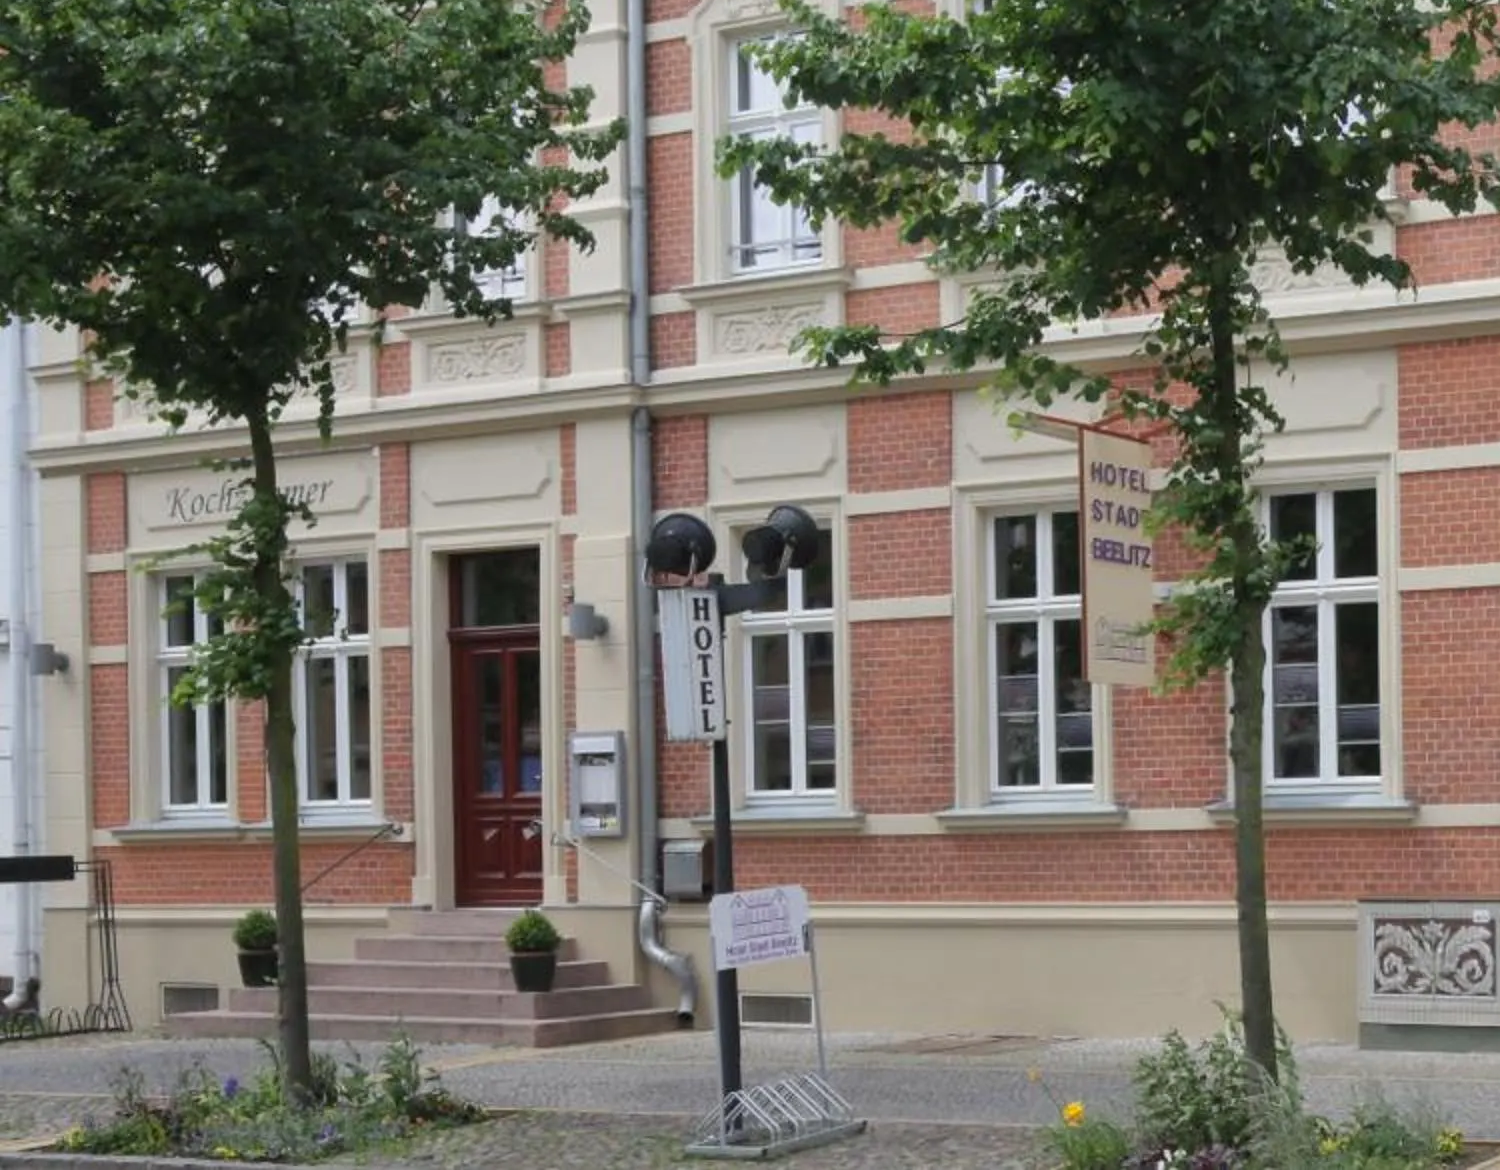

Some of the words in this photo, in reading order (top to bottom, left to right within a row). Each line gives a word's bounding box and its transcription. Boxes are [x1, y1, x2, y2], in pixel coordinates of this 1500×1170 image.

[1090, 461, 1150, 495] HOTEL
[1092, 536, 1151, 569] BEELITZ
[692, 597, 717, 733] HOTEL
